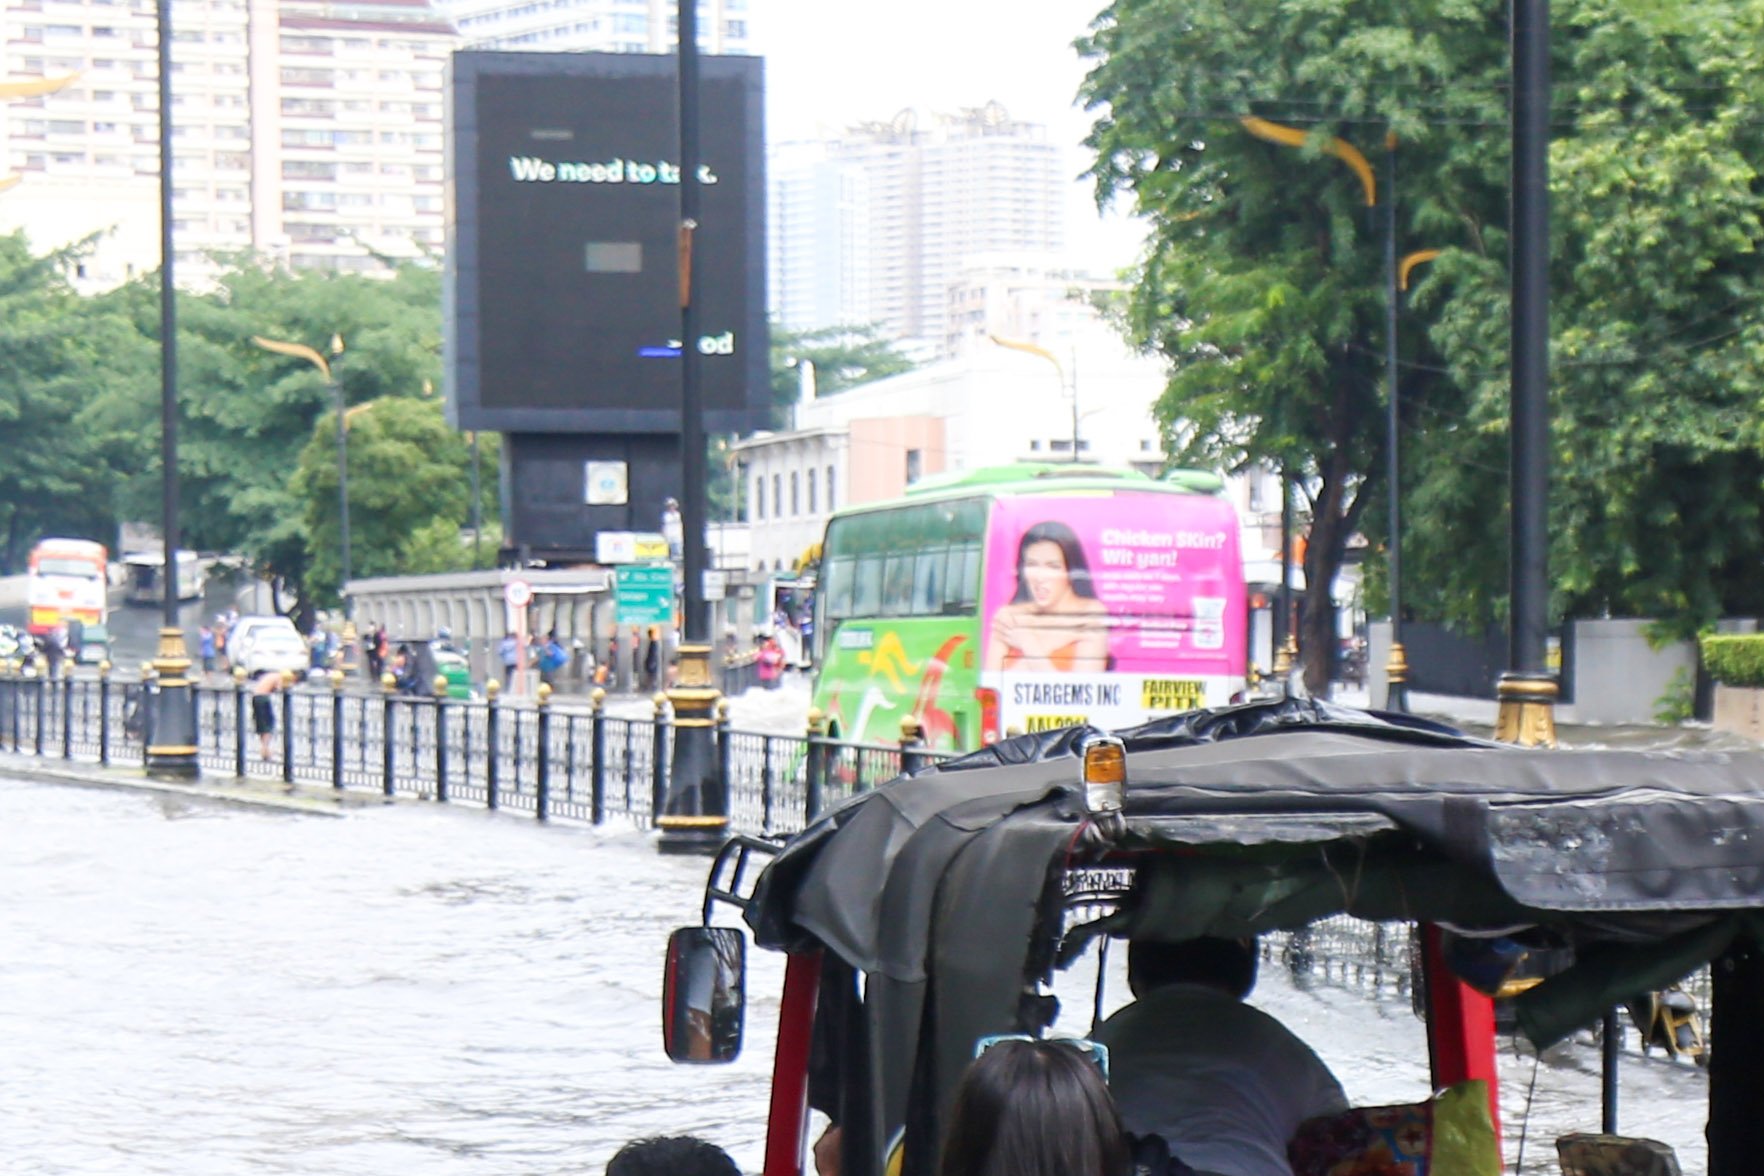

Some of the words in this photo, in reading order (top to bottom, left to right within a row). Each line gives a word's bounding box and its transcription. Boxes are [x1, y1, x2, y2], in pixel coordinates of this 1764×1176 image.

[509, 156, 556, 182] We
[557, 157, 624, 184] need
[625, 159, 657, 184] to
[1102, 529, 1173, 548] Chicken
[1136, 550, 1178, 568] yan!
[1014, 682, 1097, 706] STARGEMS
[1097, 683, 1121, 706] INC
[1143, 680, 1208, 695] FAIRVIEW
